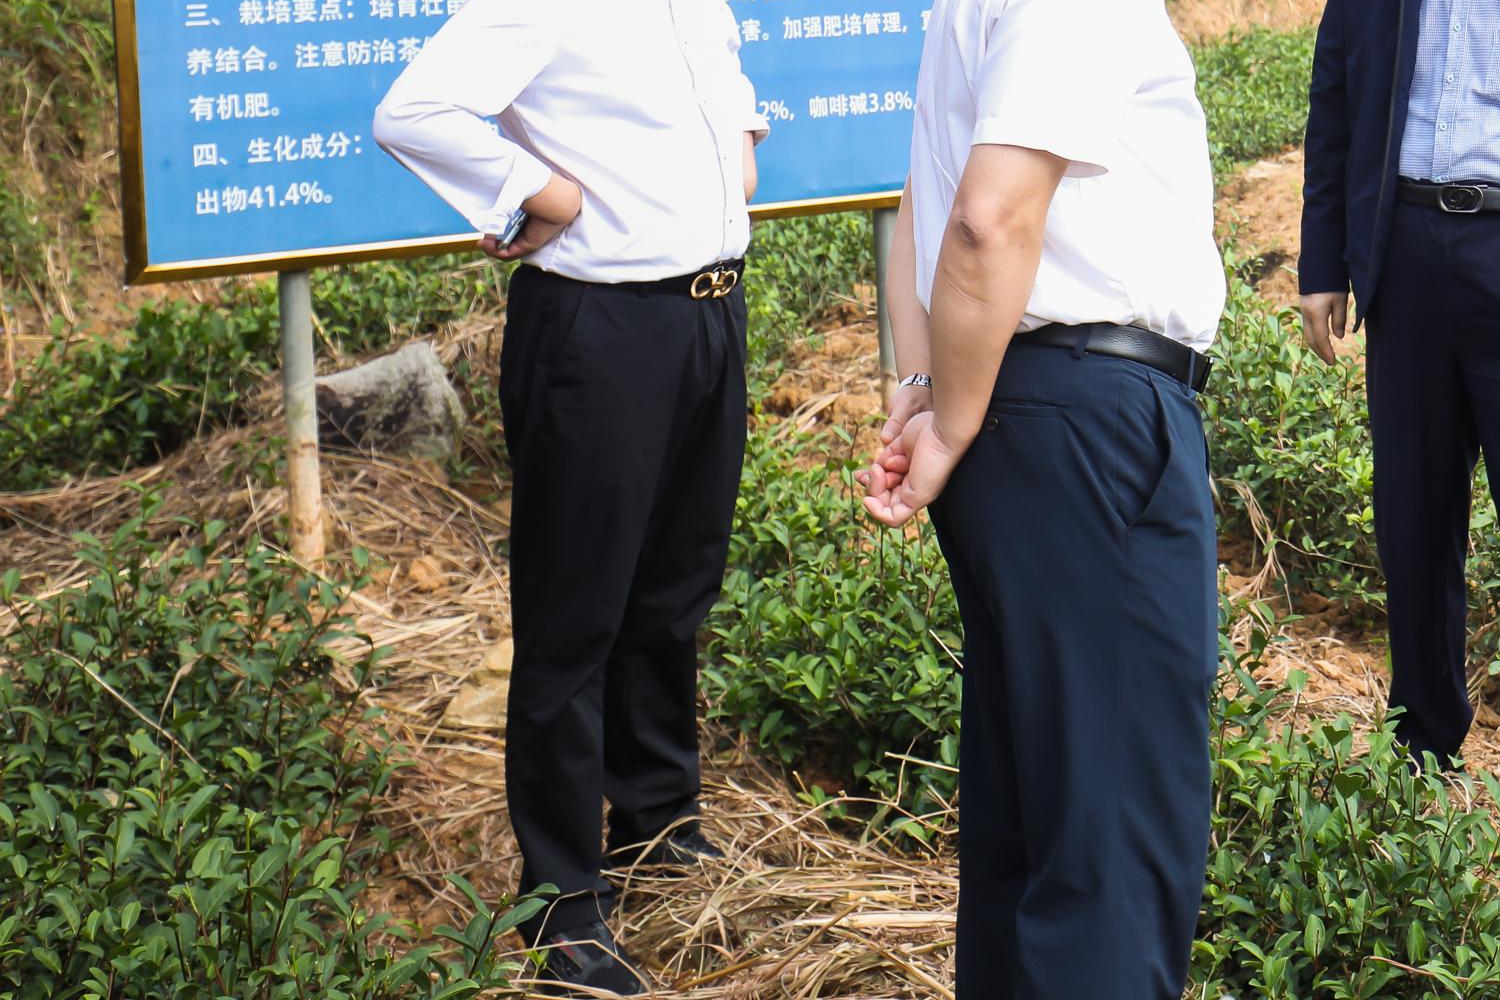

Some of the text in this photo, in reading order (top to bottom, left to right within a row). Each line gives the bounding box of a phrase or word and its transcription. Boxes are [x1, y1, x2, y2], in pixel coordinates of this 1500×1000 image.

[186, 36, 432, 76] 养结合。注意防治茶
[188, 91, 281, 122] 有机肥。
